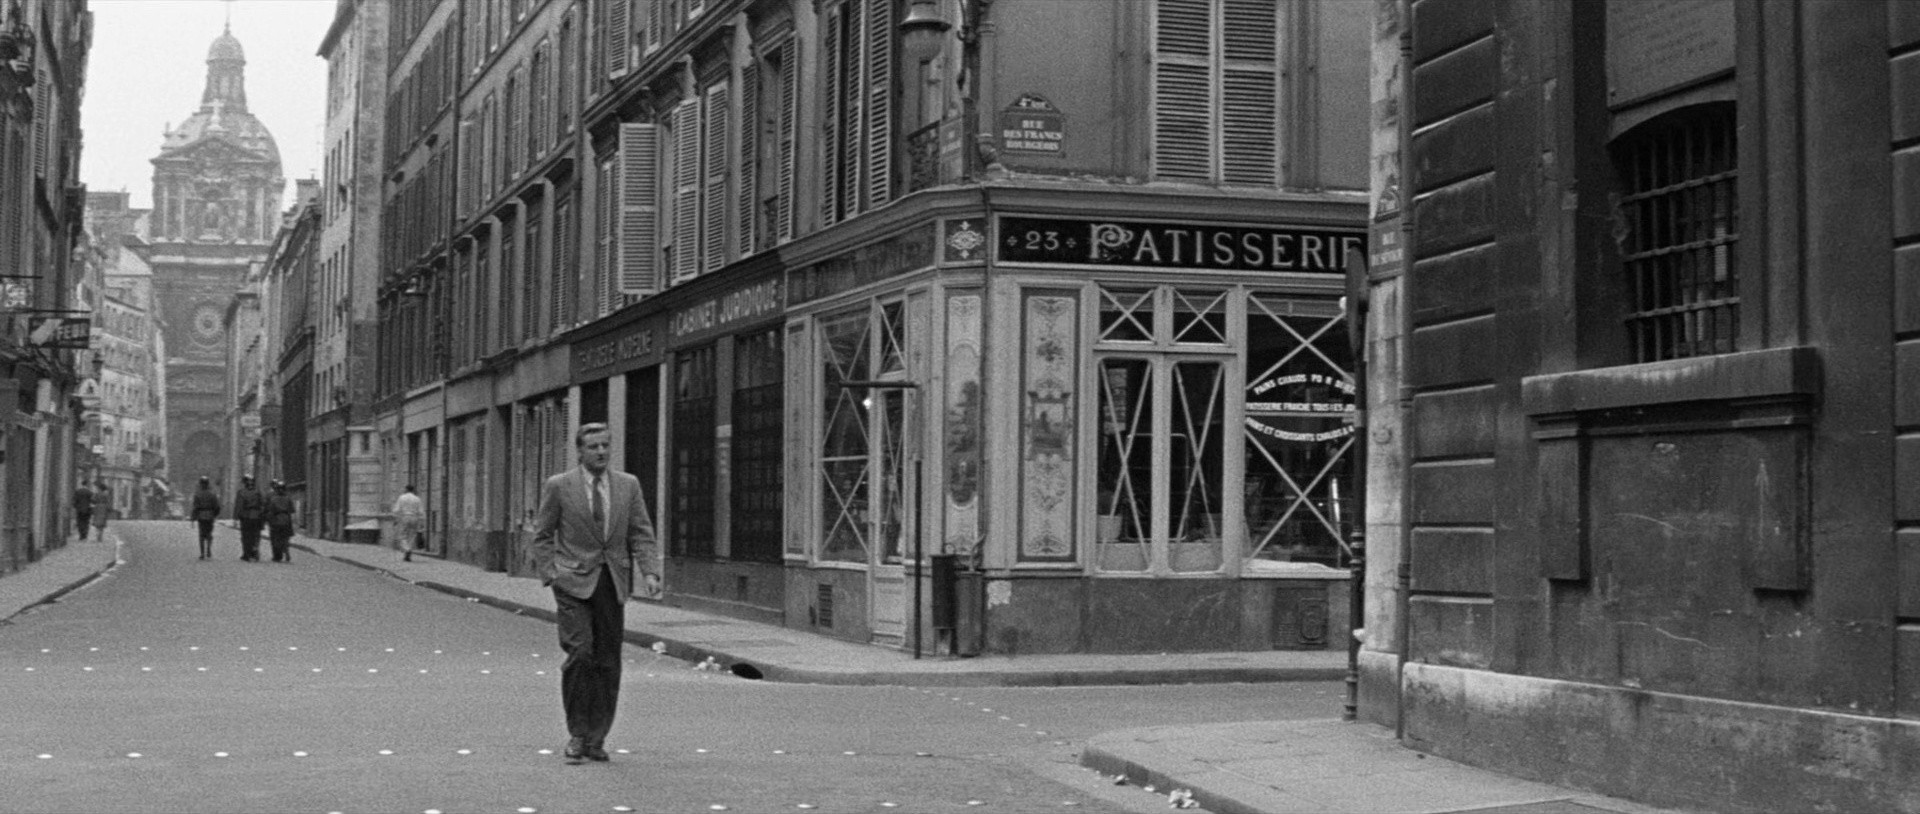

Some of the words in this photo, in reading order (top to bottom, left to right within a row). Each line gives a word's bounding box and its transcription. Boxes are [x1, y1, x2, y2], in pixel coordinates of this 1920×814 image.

[1022, 120, 1044, 129] RUE
[1003, 129, 1022, 138] DES
[1024, 130, 1063, 140] FRANCS
[1006, 140, 1059, 150] BOURGEOIS
[1025, 231, 1060, 250] 23
[676, 299, 716, 337] CABINET
[719, 279, 777, 324] JURIDIQUE
[1253, 379, 1276, 395] PAINS
[1277, 374, 1307, 386] CHAUDS
[1246, 402, 1282, 411] PATISSERIE
[1274, 429, 1315, 441] CROISSANTS
